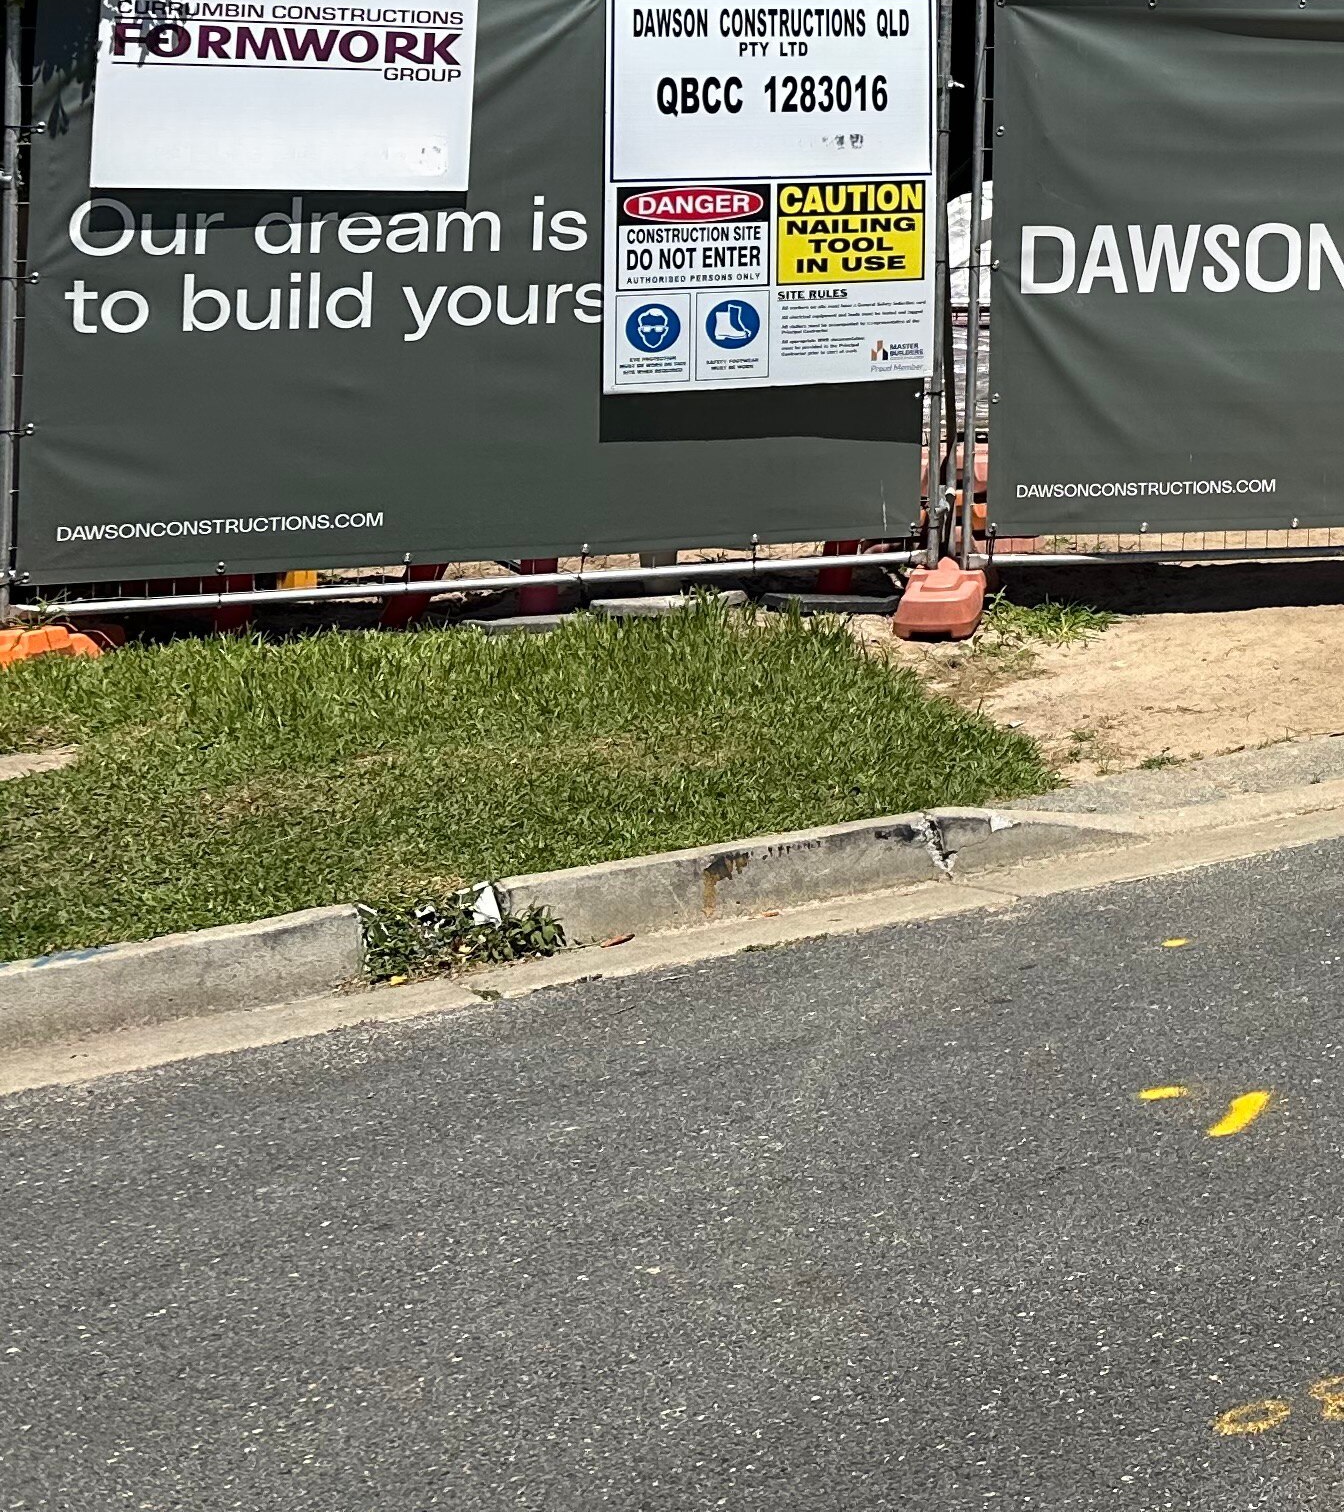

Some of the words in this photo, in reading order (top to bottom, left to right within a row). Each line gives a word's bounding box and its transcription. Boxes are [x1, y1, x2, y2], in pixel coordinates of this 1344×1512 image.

[117, 0, 264, 19] CURRUMBIN
[271, 5, 464, 25] CONSTRUCTIONS
[633, 8, 708, 37] DAWSON
[719, 8, 866, 37] CONSTRUCTIONS
[876, 8, 910, 38] QLD
[113, 22, 462, 65] FORMWORK
[739, 42, 769, 56] PTY
[780, 42, 808, 56] LTD
[383, 67, 461, 83] GROUP
[656, 76, 743, 117] QBCC
[764, 75, 888, 112] 1283016
[638, 194, 750, 215] DANGER
[779, 183, 922, 214] CAUTION
[68, 198, 224, 257] Our
[254, 196, 500, 254] dream
[531, 196, 587, 253] is
[627, 227, 730, 244] CONSTRUCTION
[733, 226, 761, 240] SITE
[786, 217, 916, 235] NAILING
[807, 237, 893, 253] TOOL
[626, 249, 651, 270] DO
[658, 247, 697, 269] NOT
[702, 245, 761, 267] ENTER
[796, 257, 828, 273] IN
[841, 255, 906, 271] USE
[627, 275, 686, 284] AUTHORISED
[690, 273, 734, 282] PERSONS
[737, 273, 761, 281] ONLY
[64, 279, 149, 334] to
[181, 272, 373, 332] build
[777, 290, 805, 300] SITE
[808, 289, 848, 299] RULES
[1016, 478, 1277, 499] DAWSONCONSTRUCTIONS.COM
[56, 510, 384, 542] DAWSONCONSTRUCTIONS.COM
